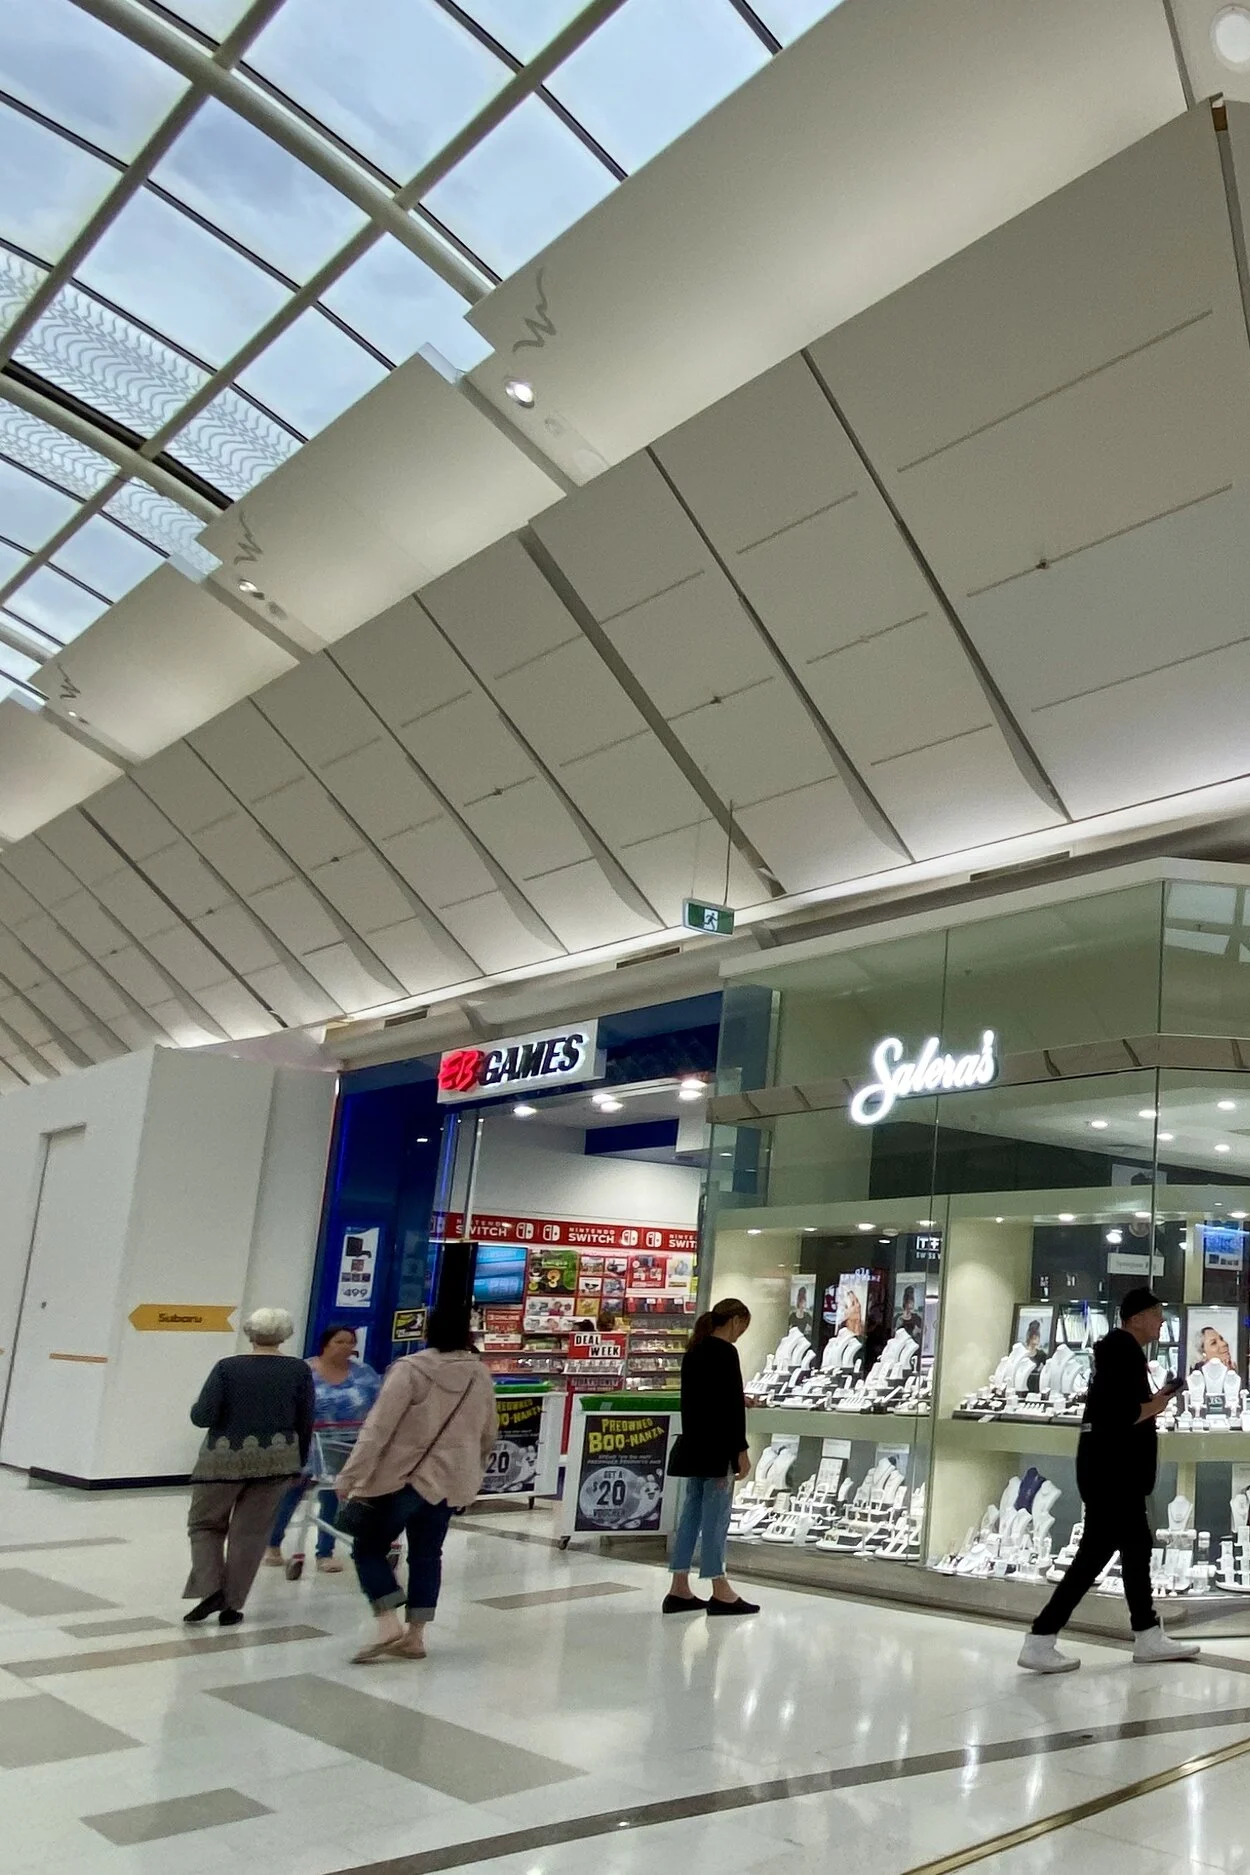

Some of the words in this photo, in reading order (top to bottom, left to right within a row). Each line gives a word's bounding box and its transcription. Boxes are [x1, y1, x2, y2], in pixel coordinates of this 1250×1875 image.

[438, 1049, 484, 1092] EB
[479, 1033, 585, 1086] GAMES
[850, 1029, 996, 1125] Salera's
[568, 1233, 615, 1244] SWITCH
[668, 1239, 697, 1249] SWIT
[158, 1312, 203, 1323] Subaru
[575, 1334, 600, 1345] DEAL
[590, 1346, 620, 1357] WEEK
[601, 1418, 654, 1433] PREOWNED
[588, 1426, 665, 1454] BOO-NANZA
[485, 1451, 510, 1474] 20
